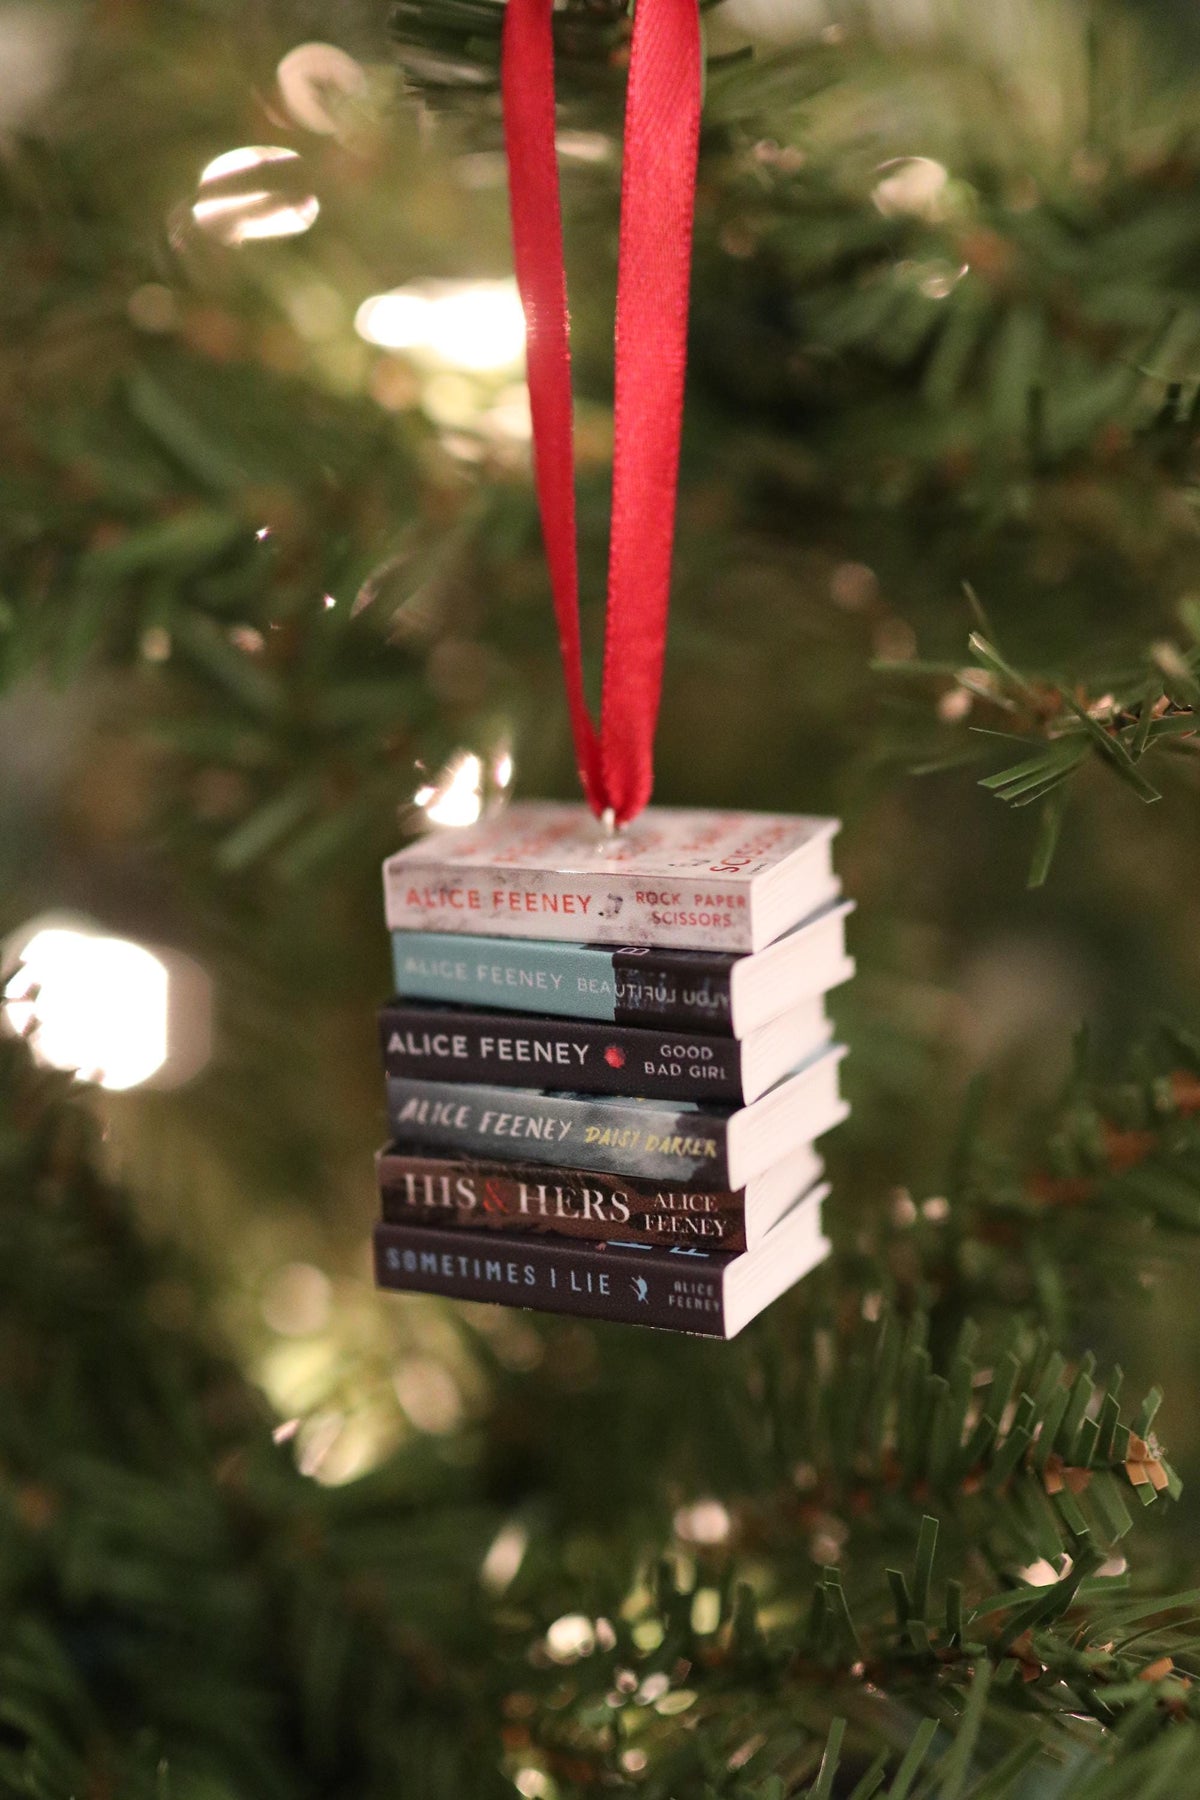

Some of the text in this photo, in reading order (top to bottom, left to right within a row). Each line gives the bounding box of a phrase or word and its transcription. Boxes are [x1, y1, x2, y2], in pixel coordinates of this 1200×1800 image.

[405, 886, 592, 914] ALICE FEENEY
[635, 891, 746, 909] ROCK PAPER
[652, 911, 732, 928] SCISSORS
[405, 957, 466, 980] ALICE
[476, 963, 562, 990] FEENEY
[388, 1032, 588, 1065] ALICE FEENEY
[660, 1044, 713, 1060] GOOD
[644, 1061, 727, 1080] BAD GIRL
[399, 1097, 718, 1158] ALICE FEENEY DAISY DARKER
[405, 1173, 630, 1224] HIS & HERS
[654, 1192, 718, 1213] ALICE
[645, 1214, 727, 1238] FEENEY
[387, 1248, 611, 1296] SOMETIMES I LIE
[674, 1281, 714, 1297] ALICE
[668, 1296, 721, 1313] FEENEY
